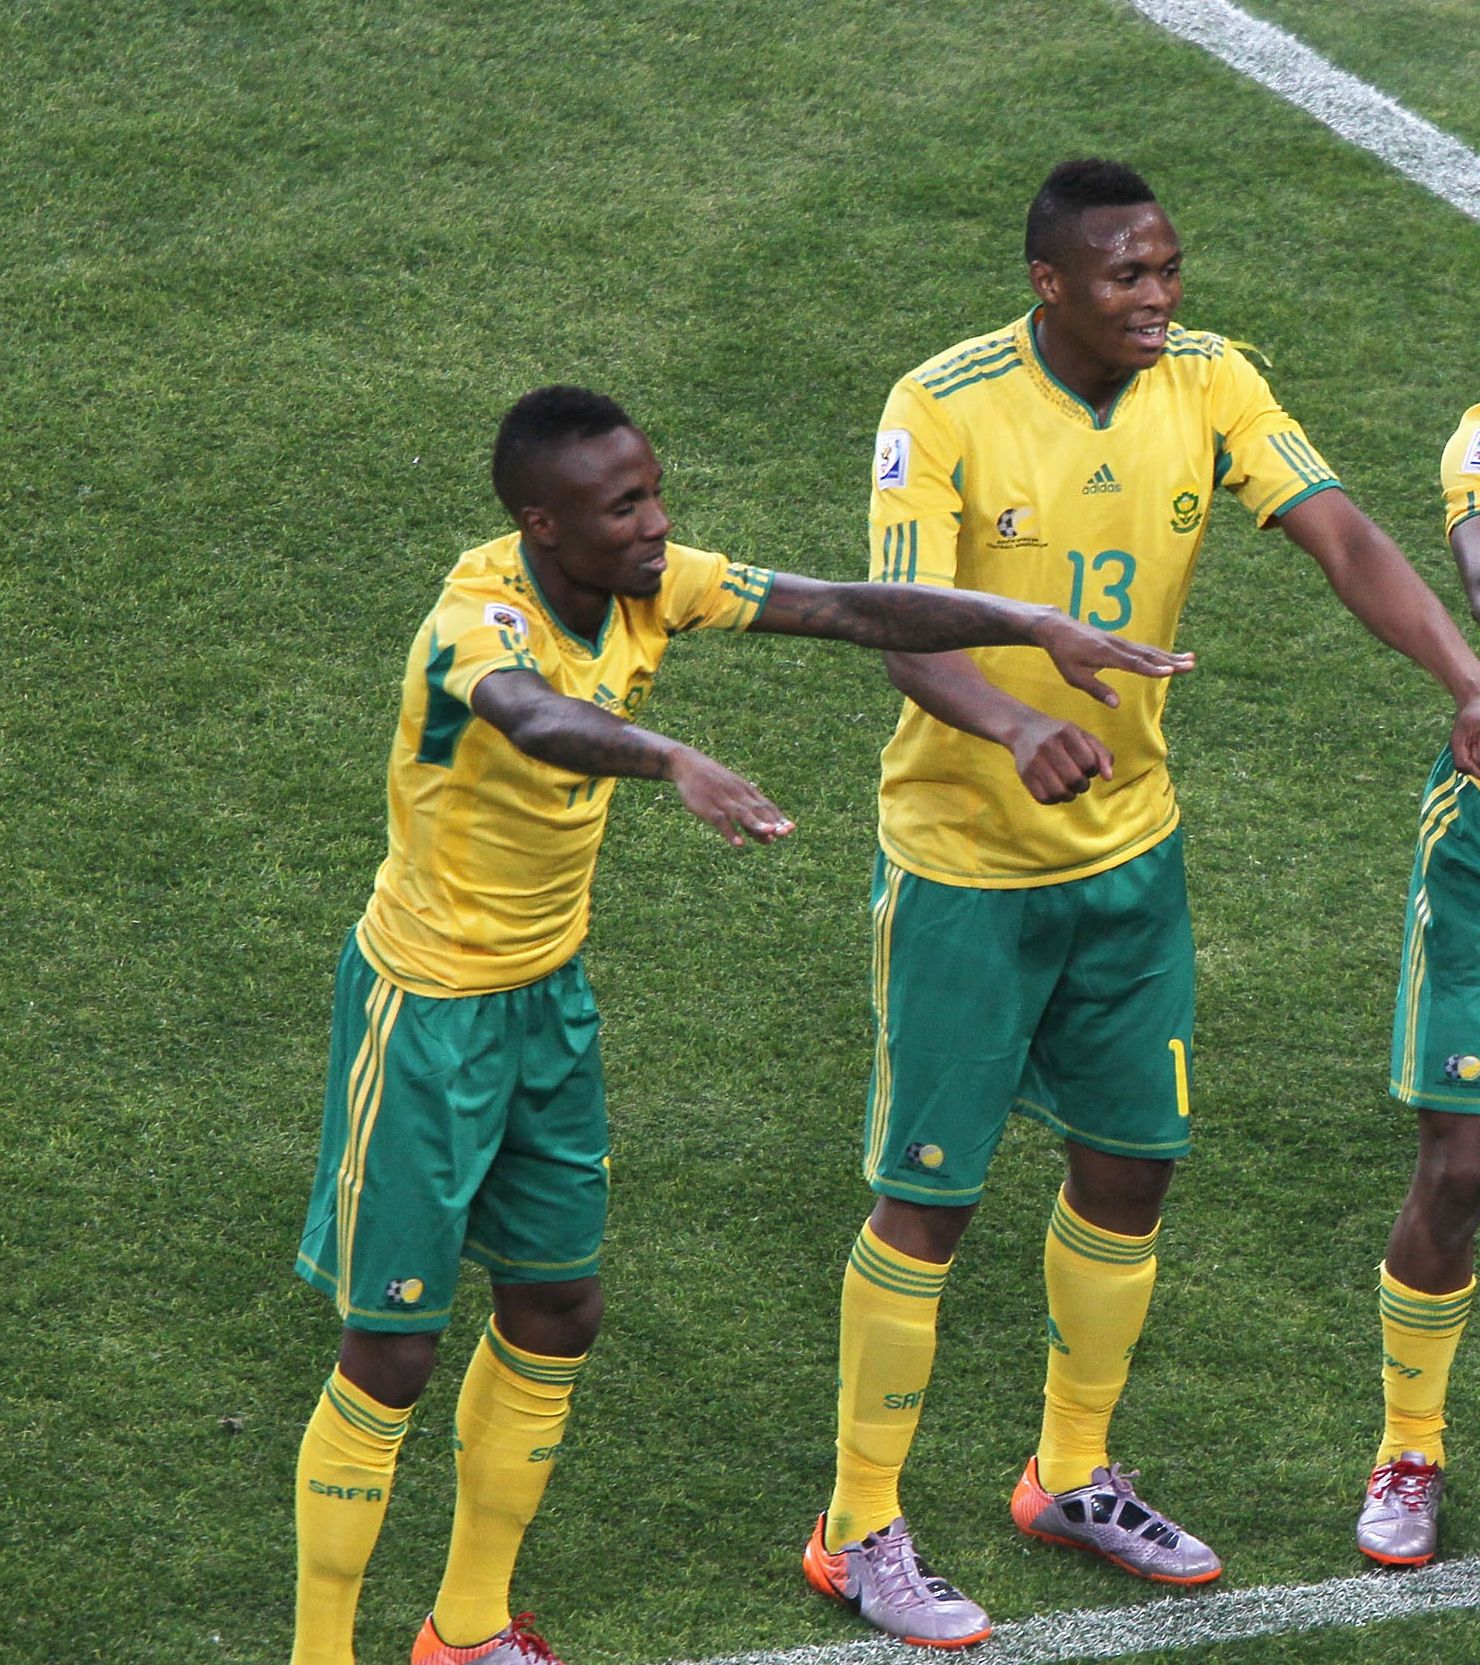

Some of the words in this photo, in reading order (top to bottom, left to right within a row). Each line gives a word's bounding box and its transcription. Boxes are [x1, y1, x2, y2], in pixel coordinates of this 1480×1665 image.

[1082, 483, 1122, 495] adidas
[1067, 549, 1137, 632] 13
[1168, 1038, 1189, 1117] 1
[308, 1479, 382, 1502] SAFA
